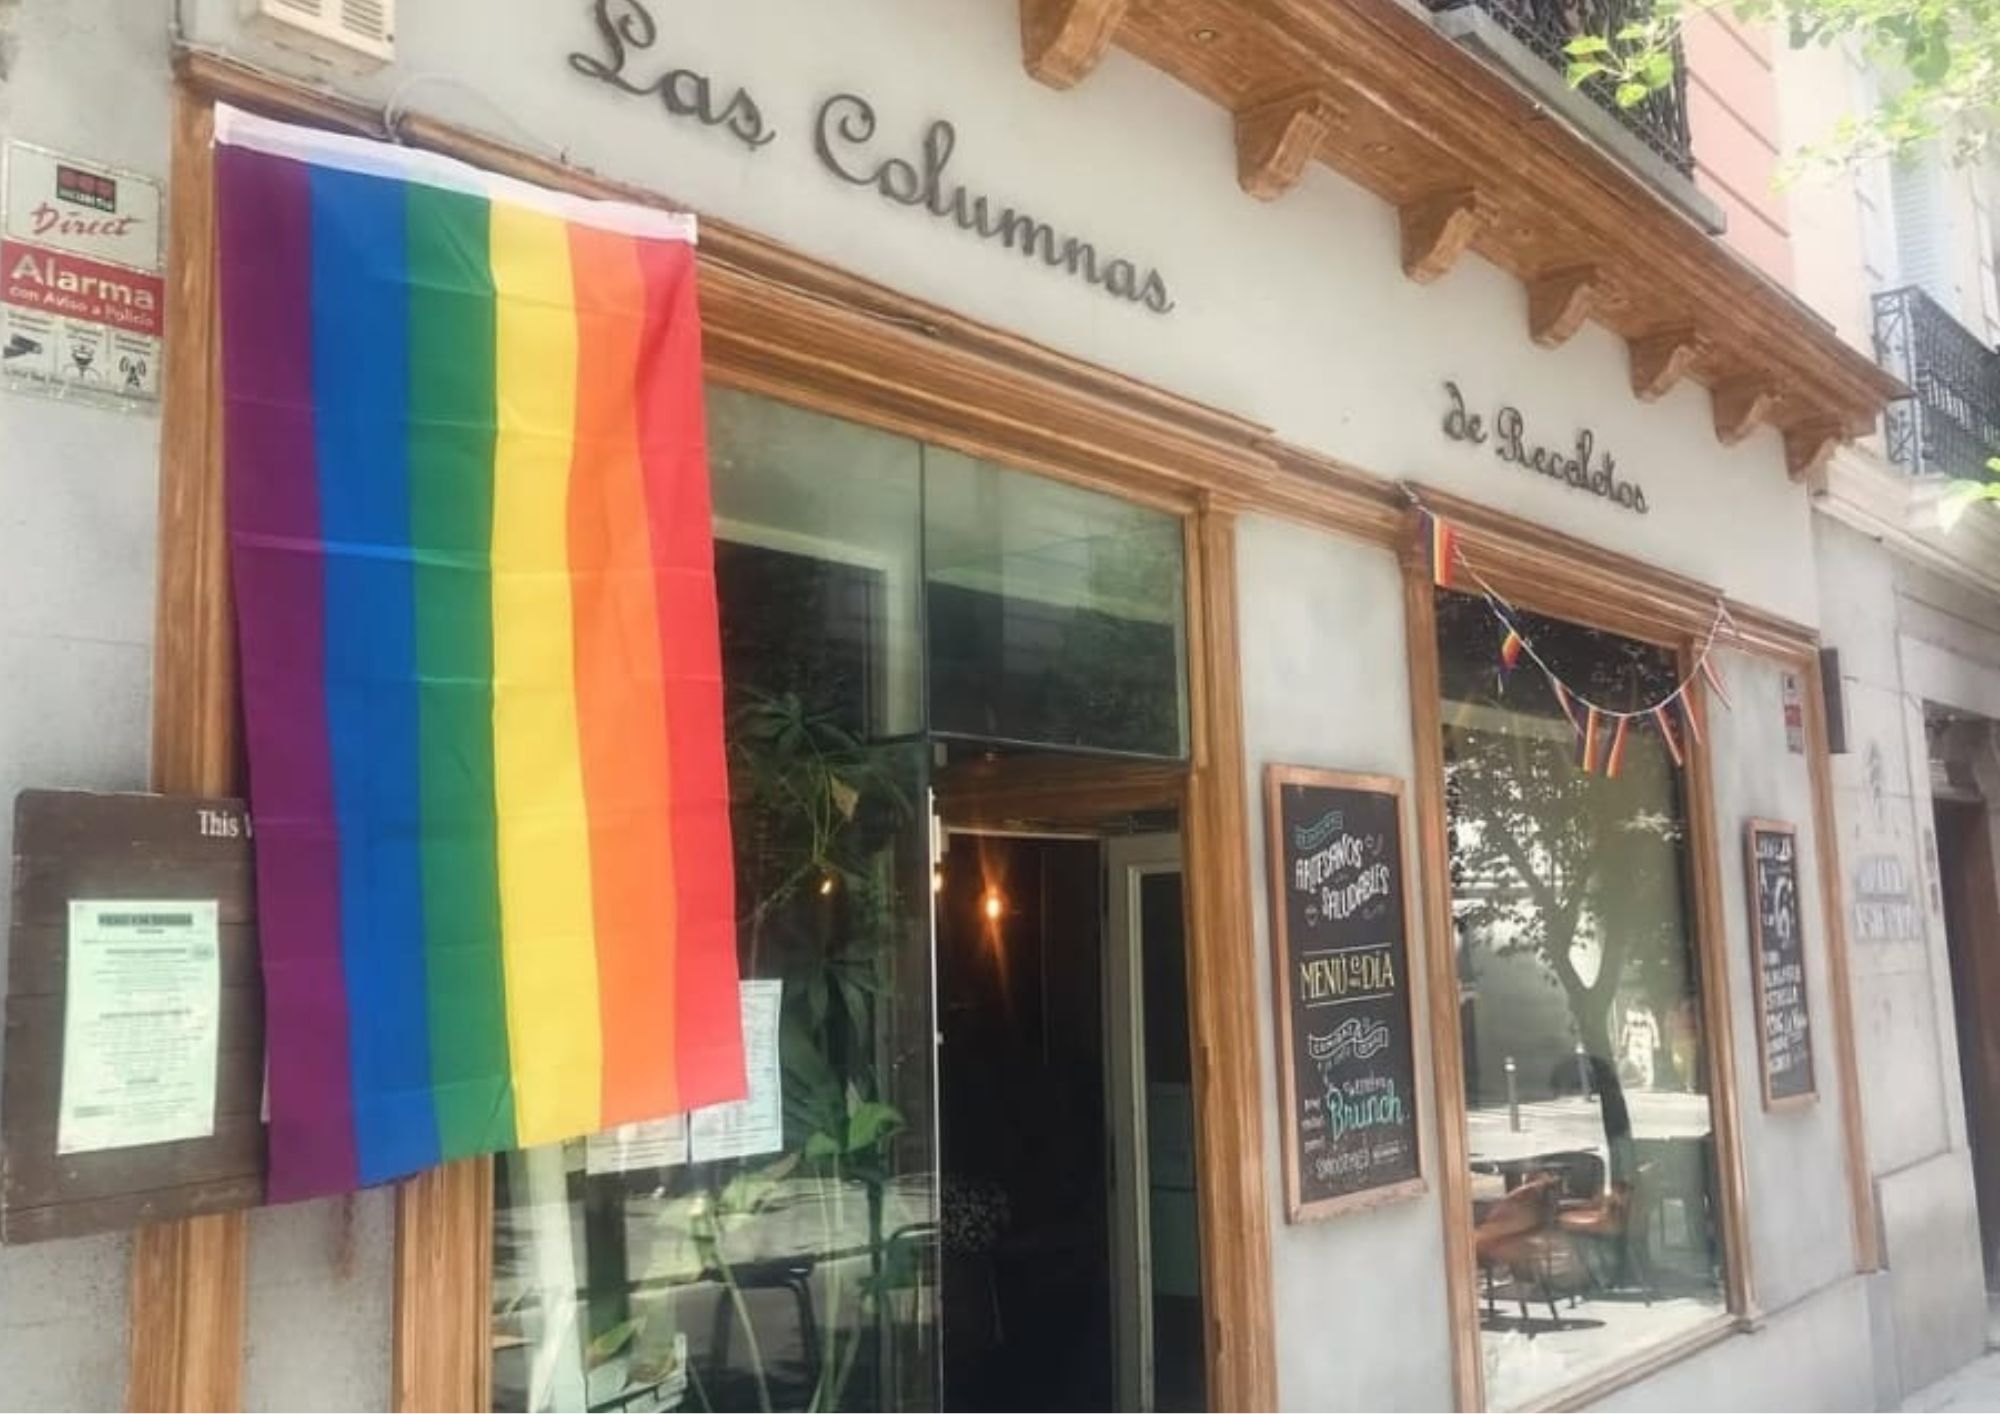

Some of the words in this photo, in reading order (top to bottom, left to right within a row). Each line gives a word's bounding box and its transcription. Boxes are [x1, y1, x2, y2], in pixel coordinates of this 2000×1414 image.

[568, 0, 776, 151] Las
[812, 93, 1175, 314] Columnas
[31, 201, 146, 237] Direct
[9, 286, 40, 302] con
[43, 291, 89, 312] Aviso
[10, 253, 155, 311] Alarma
[1442, 380, 1488, 443] de
[1495, 406, 1650, 514] Recoletos
[196, 809, 240, 837] This
[1327, 1078, 1404, 1142] Brunch
